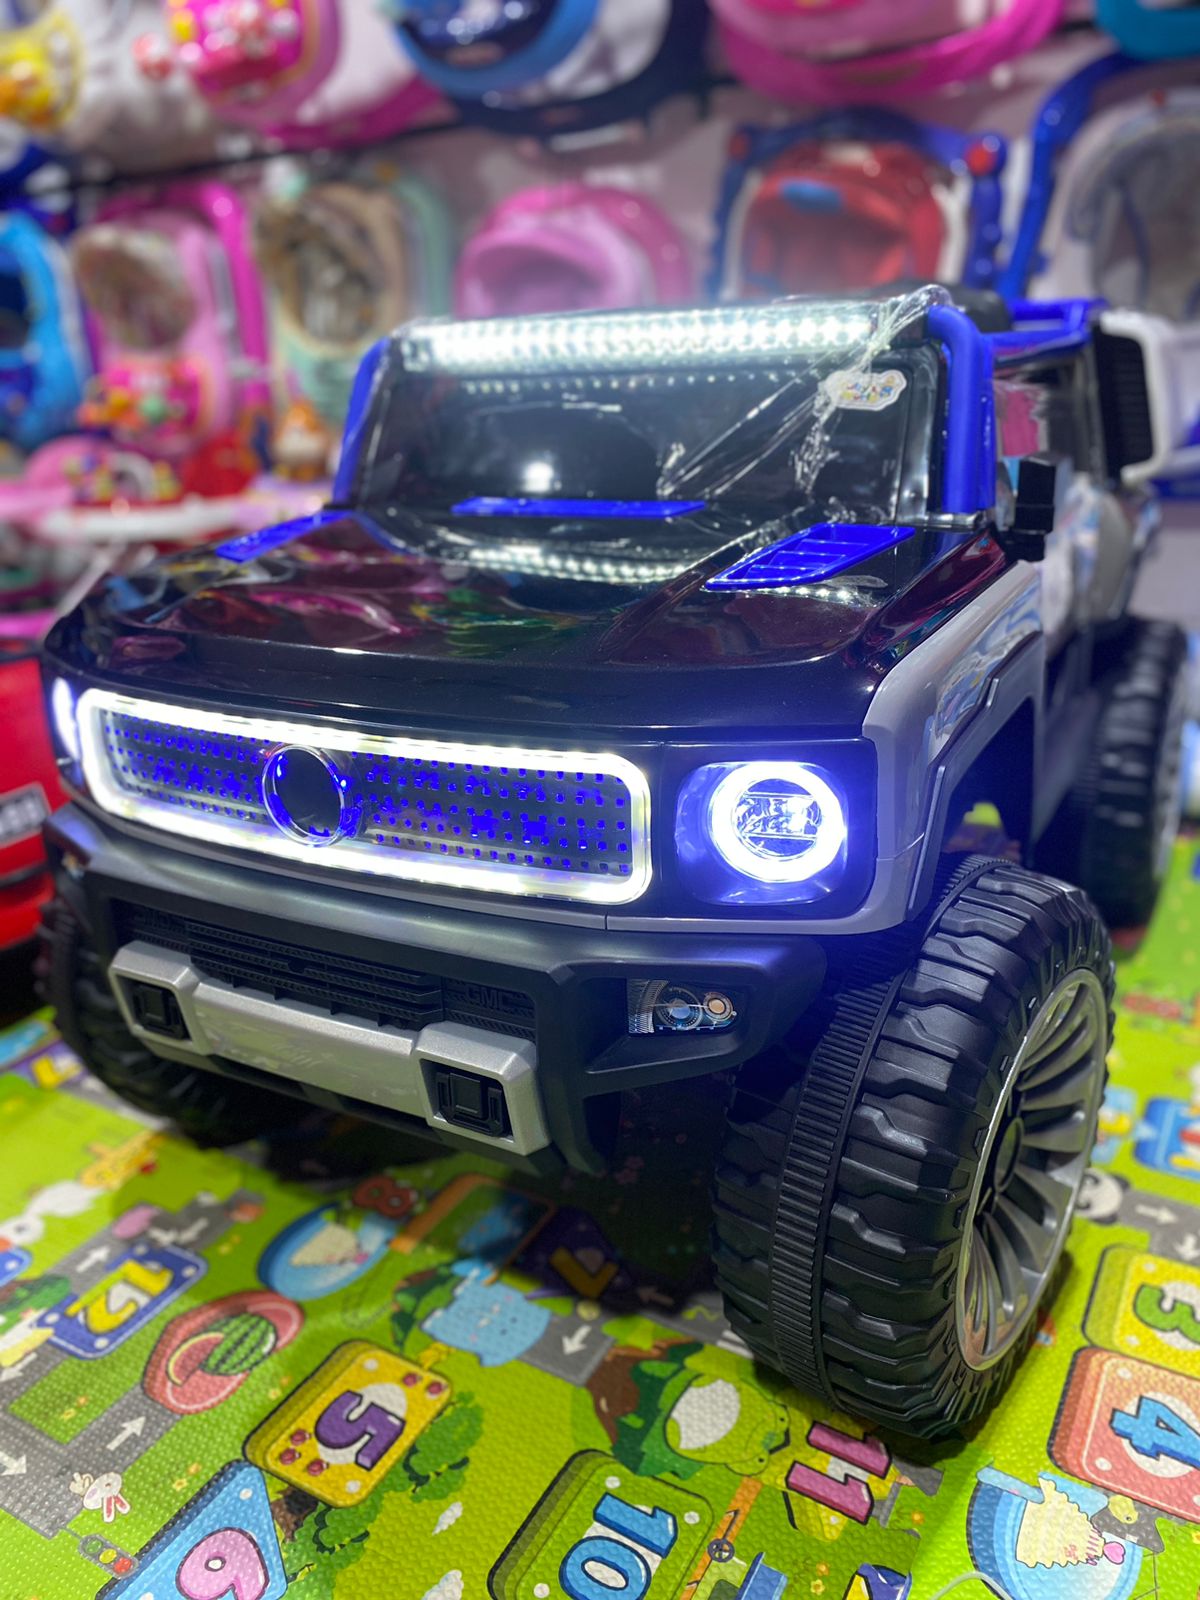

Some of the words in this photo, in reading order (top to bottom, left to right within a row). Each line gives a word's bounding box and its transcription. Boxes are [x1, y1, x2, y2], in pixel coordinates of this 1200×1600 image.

[64, 1258, 174, 1334] 12
[1133, 1282, 1200, 1346] 3
[314, 1389, 407, 1472] 5
[1109, 1395, 1200, 1471] 4
[785, 1420, 892, 1526] 11
[559, 1491, 679, 1600] 10
